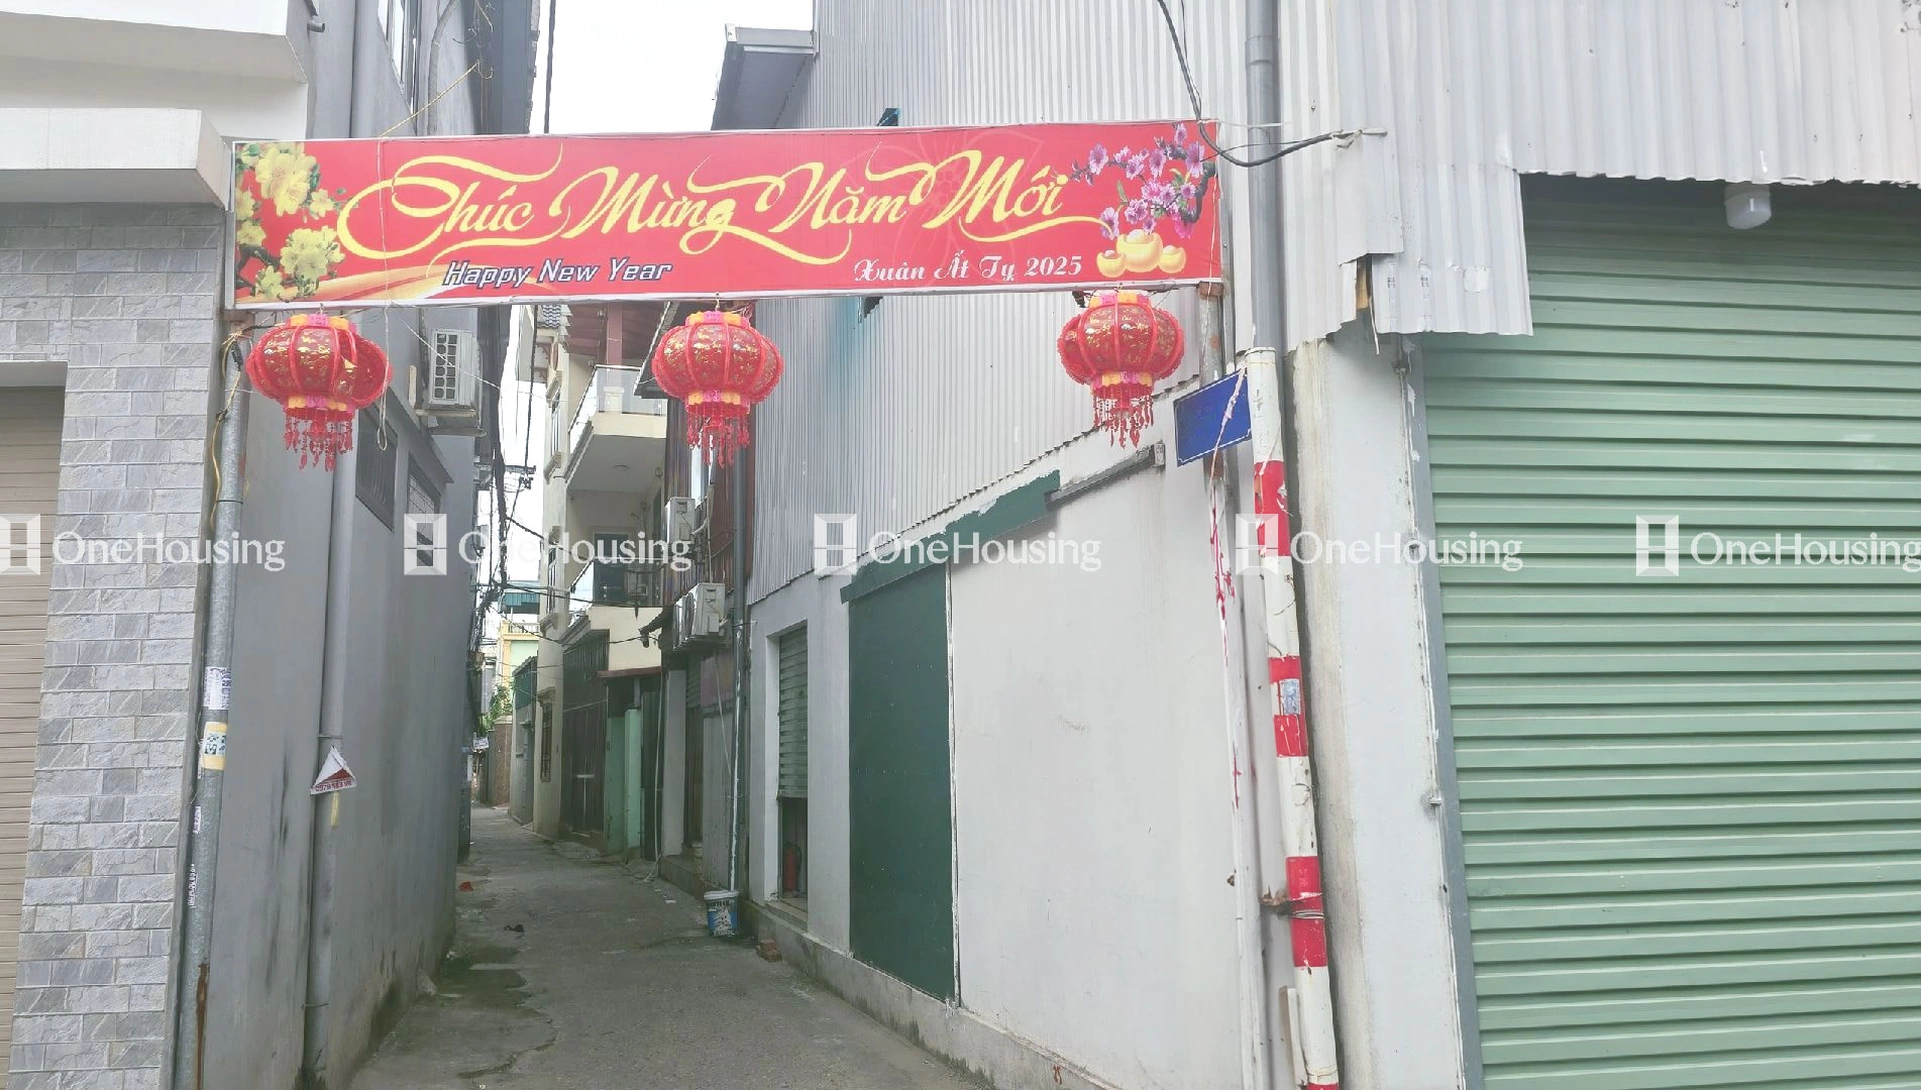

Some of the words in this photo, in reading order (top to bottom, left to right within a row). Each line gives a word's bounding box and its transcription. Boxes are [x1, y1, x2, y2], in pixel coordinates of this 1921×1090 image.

[549, 165, 852, 266] Mừng
[687, 155, 909, 233] Năm
[442, 260, 533, 289] Happy
[537, 258, 599, 284] New
[608, 256, 674, 282] Year
[854, 258, 925, 282] Xuân
[933, 250, 970, 280] Ất
[1024, 255, 1083, 277] 2025
